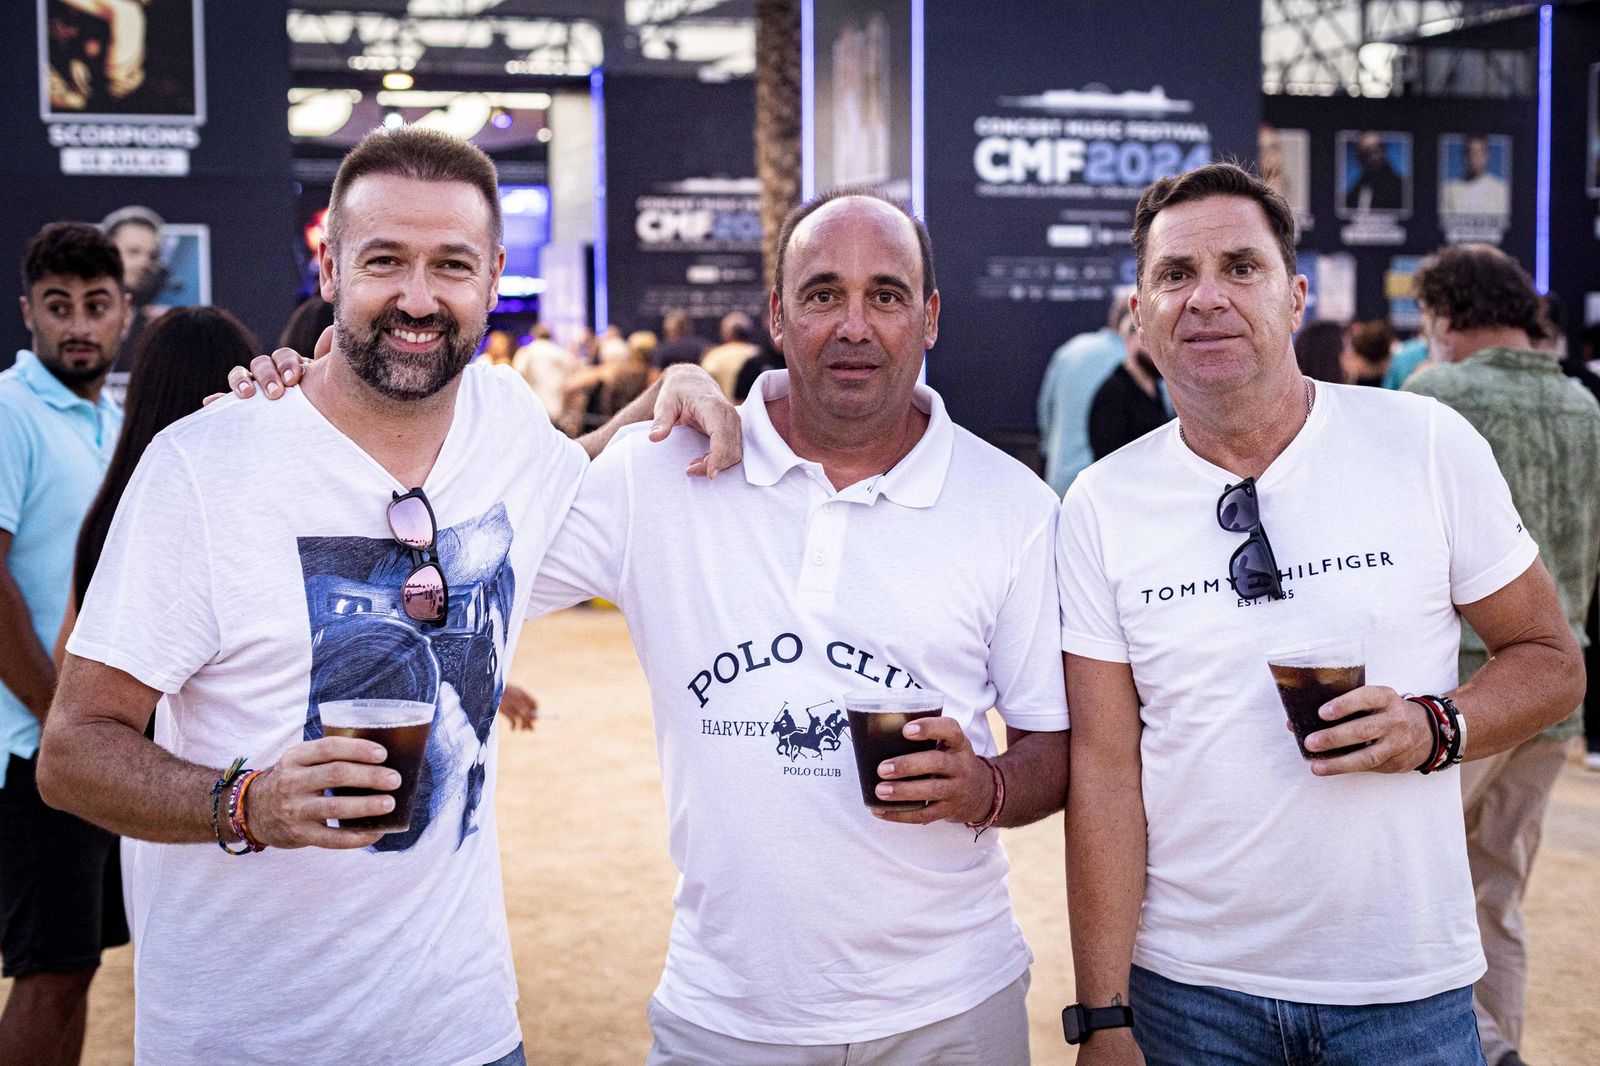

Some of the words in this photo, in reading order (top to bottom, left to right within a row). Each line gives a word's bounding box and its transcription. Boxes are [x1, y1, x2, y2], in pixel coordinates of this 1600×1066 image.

[48, 124, 200, 149] SCORPIONS
[636, 208, 763, 244] CMF20
[1141, 577, 1238, 605] TOMMY
[1279, 551, 1394, 582] HILFIGER
[1267, 589, 1295, 603] 185
[687, 632, 803, 709] POLO
[826, 641, 924, 690] CLU
[701, 719, 770, 737] HARVEY
[783, 766, 811, 776] POLO
[813, 768, 842, 778] CLUB
